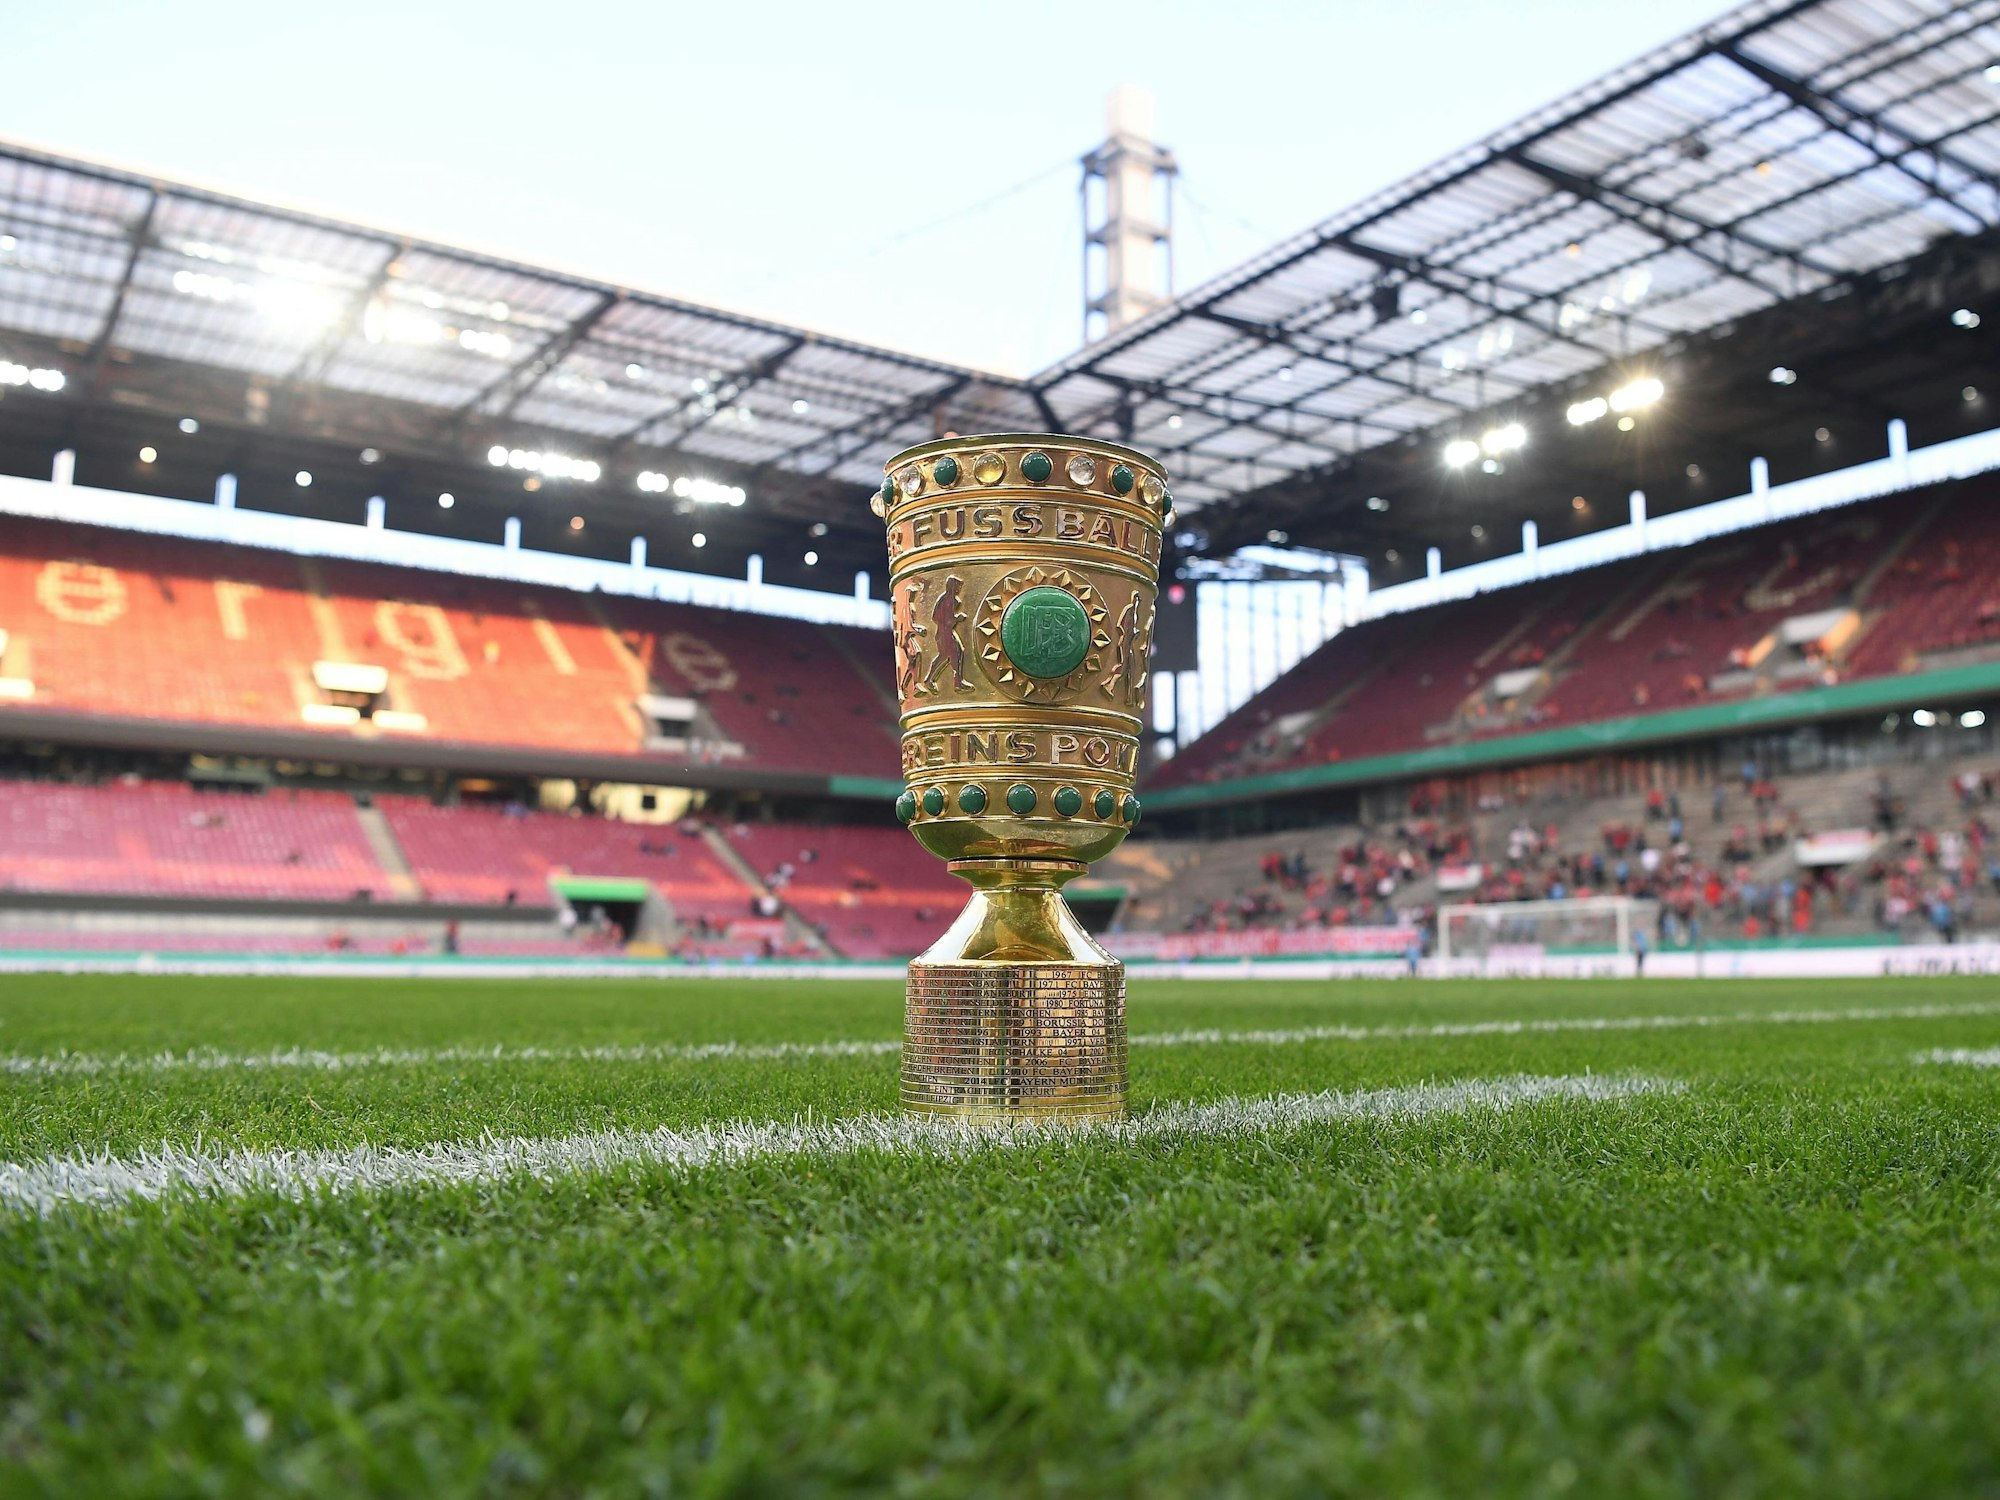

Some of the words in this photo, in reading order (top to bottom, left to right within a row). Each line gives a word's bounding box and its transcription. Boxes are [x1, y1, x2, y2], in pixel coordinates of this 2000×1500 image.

[911, 504, 1150, 556] FUSSBALL
[1065, 980, 1078, 988] FC
[1060, 990, 1077, 998] 1975
[1037, 1019, 1087, 1027] BORUSSIA
[1021, 1029, 1042, 1037] 1993
[1053, 1029, 1086, 1037] BAYER
[1066, 1038, 1081, 1046] 1997
[1025, 1058, 1048, 1066] 2006
[1059, 1058, 1072, 1066] FC
[1079, 1057, 1111, 1065] BAYERN
[934, 1066, 974, 1075] BREMEN
[1033, 1068, 1047, 1076] FC
[1053, 1067, 1092, 1076] BAYERN
[964, 1077, 986, 1085] 2014
[1012, 1078, 1056, 1086] AYERN
[990, 1087, 1056, 1096] FRAKFURT
